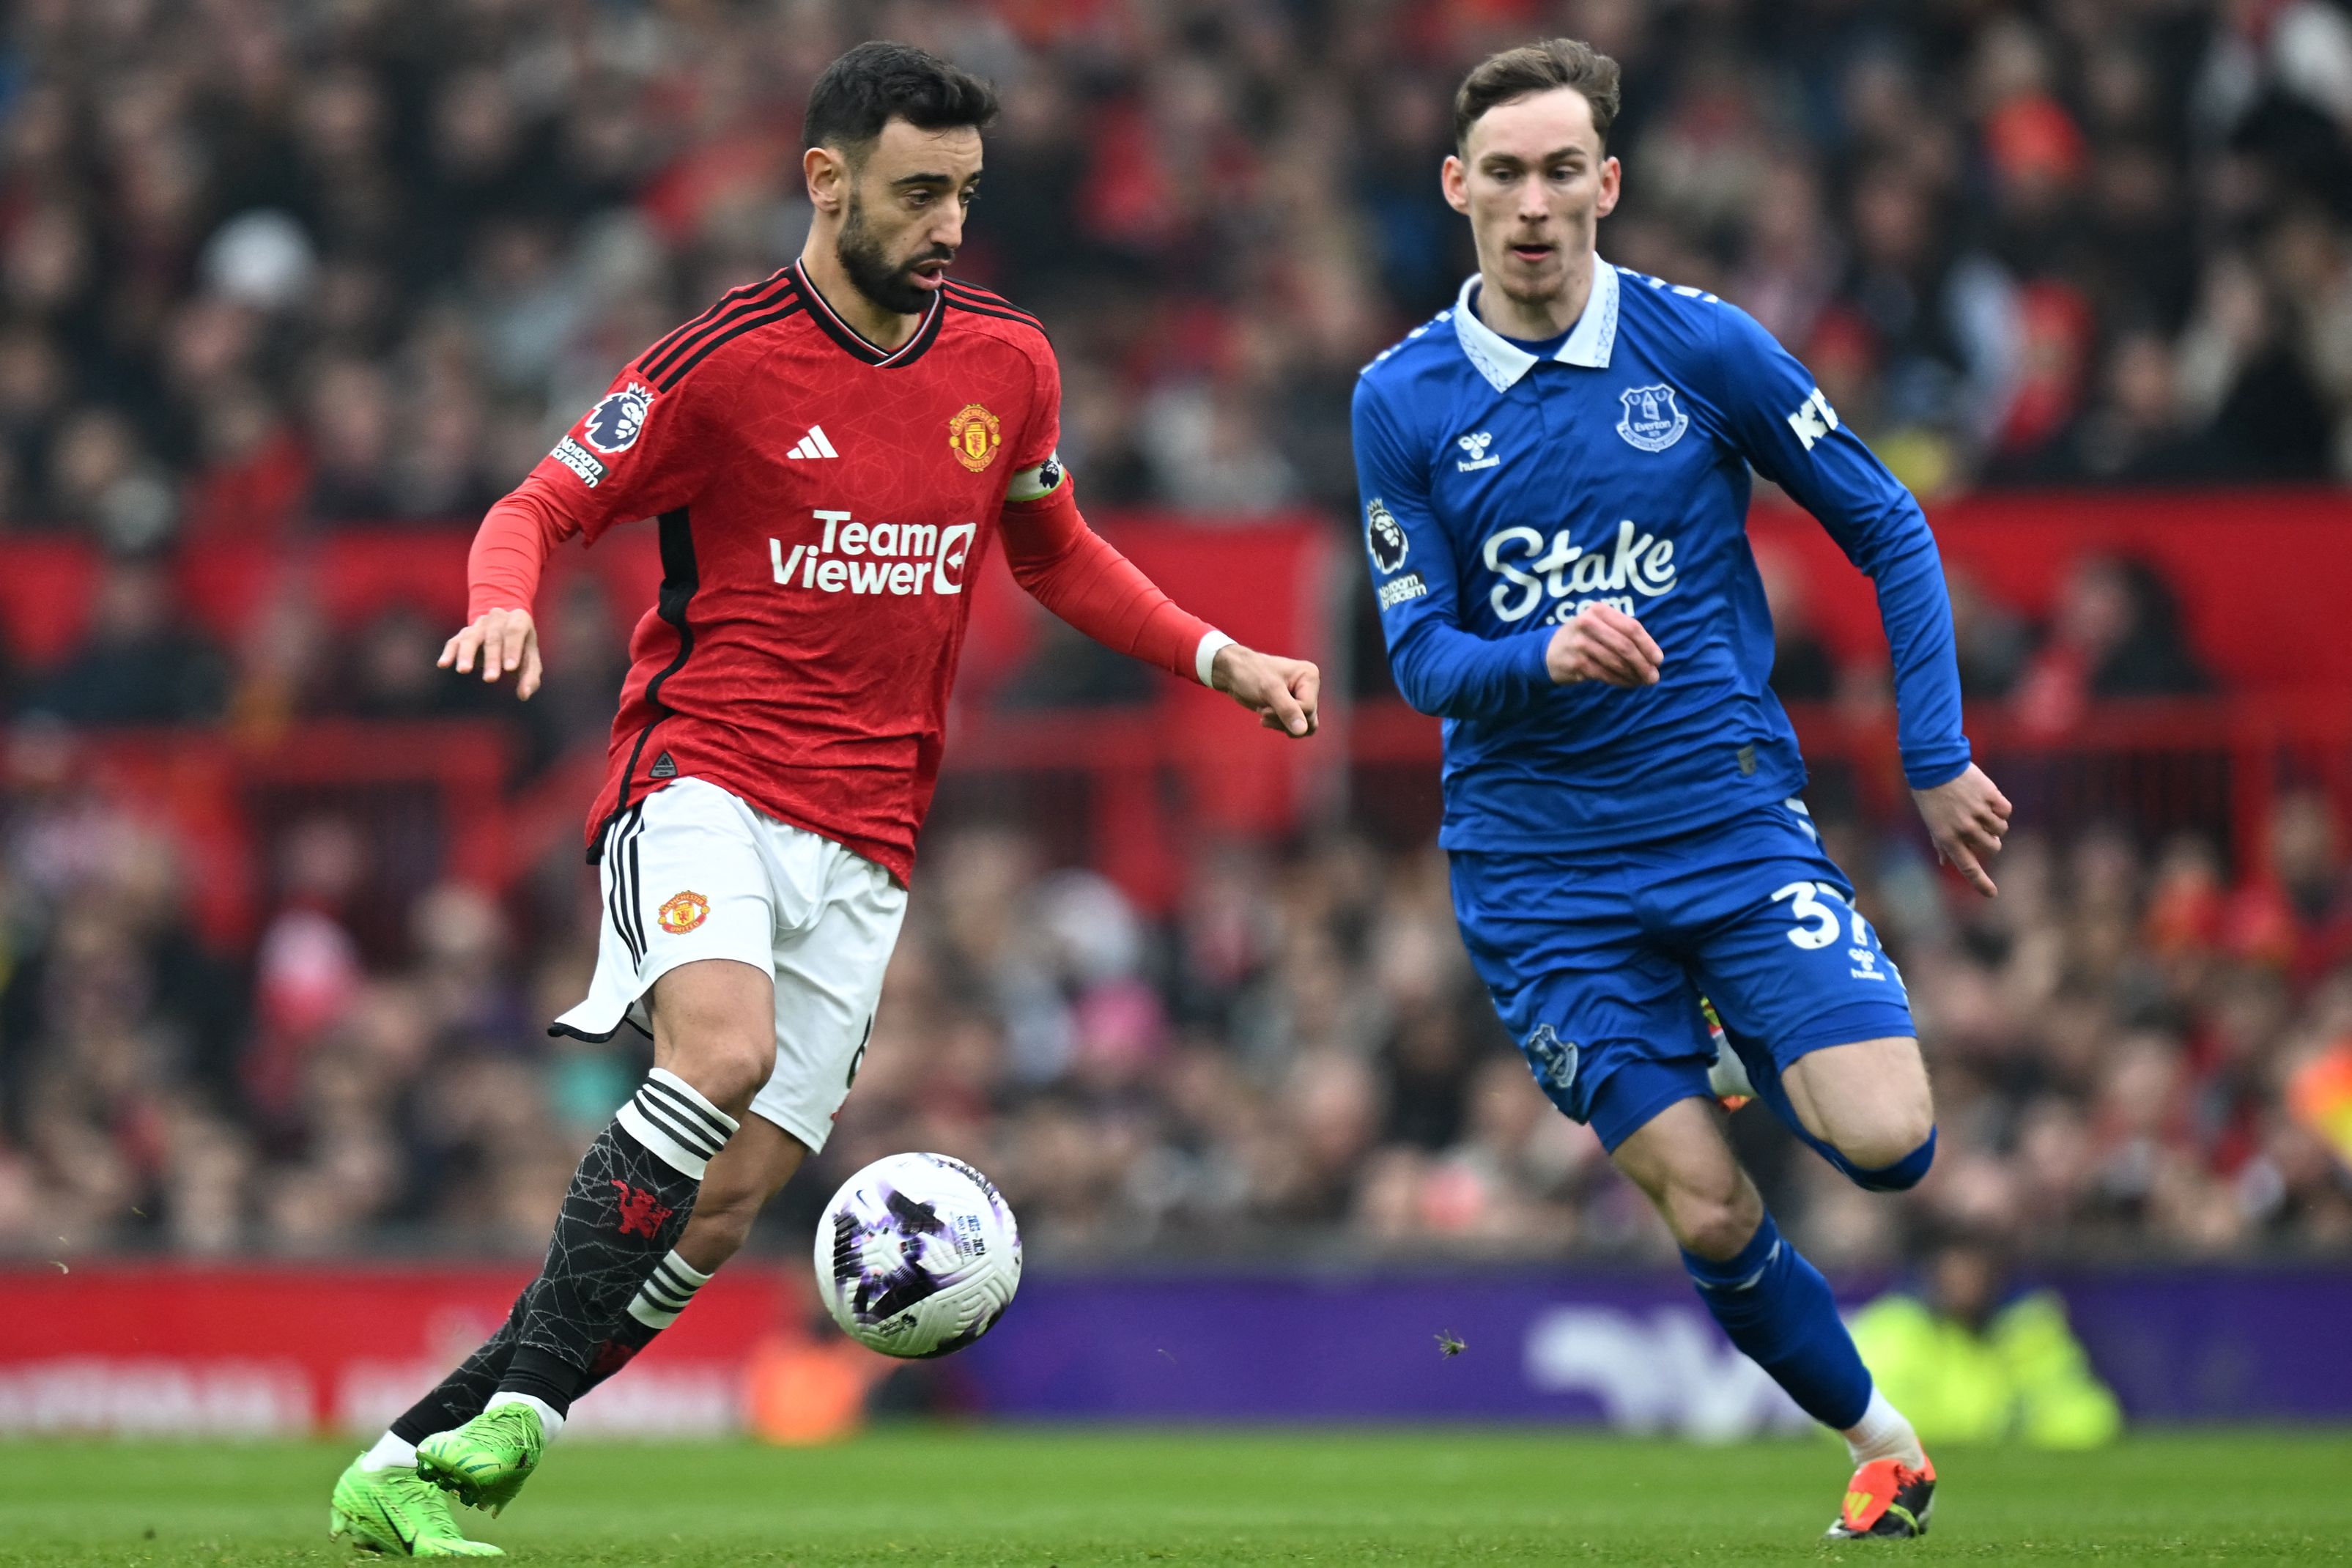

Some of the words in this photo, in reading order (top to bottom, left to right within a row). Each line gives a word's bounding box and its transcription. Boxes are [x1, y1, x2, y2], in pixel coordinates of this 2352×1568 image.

[1634, 421, 1671, 432] Everton
[1458, 454, 1501, 472] hummel
[813, 509, 938, 557] Team
[769, 538, 931, 594] Viewer
[1483, 520, 1676, 622] Stake
